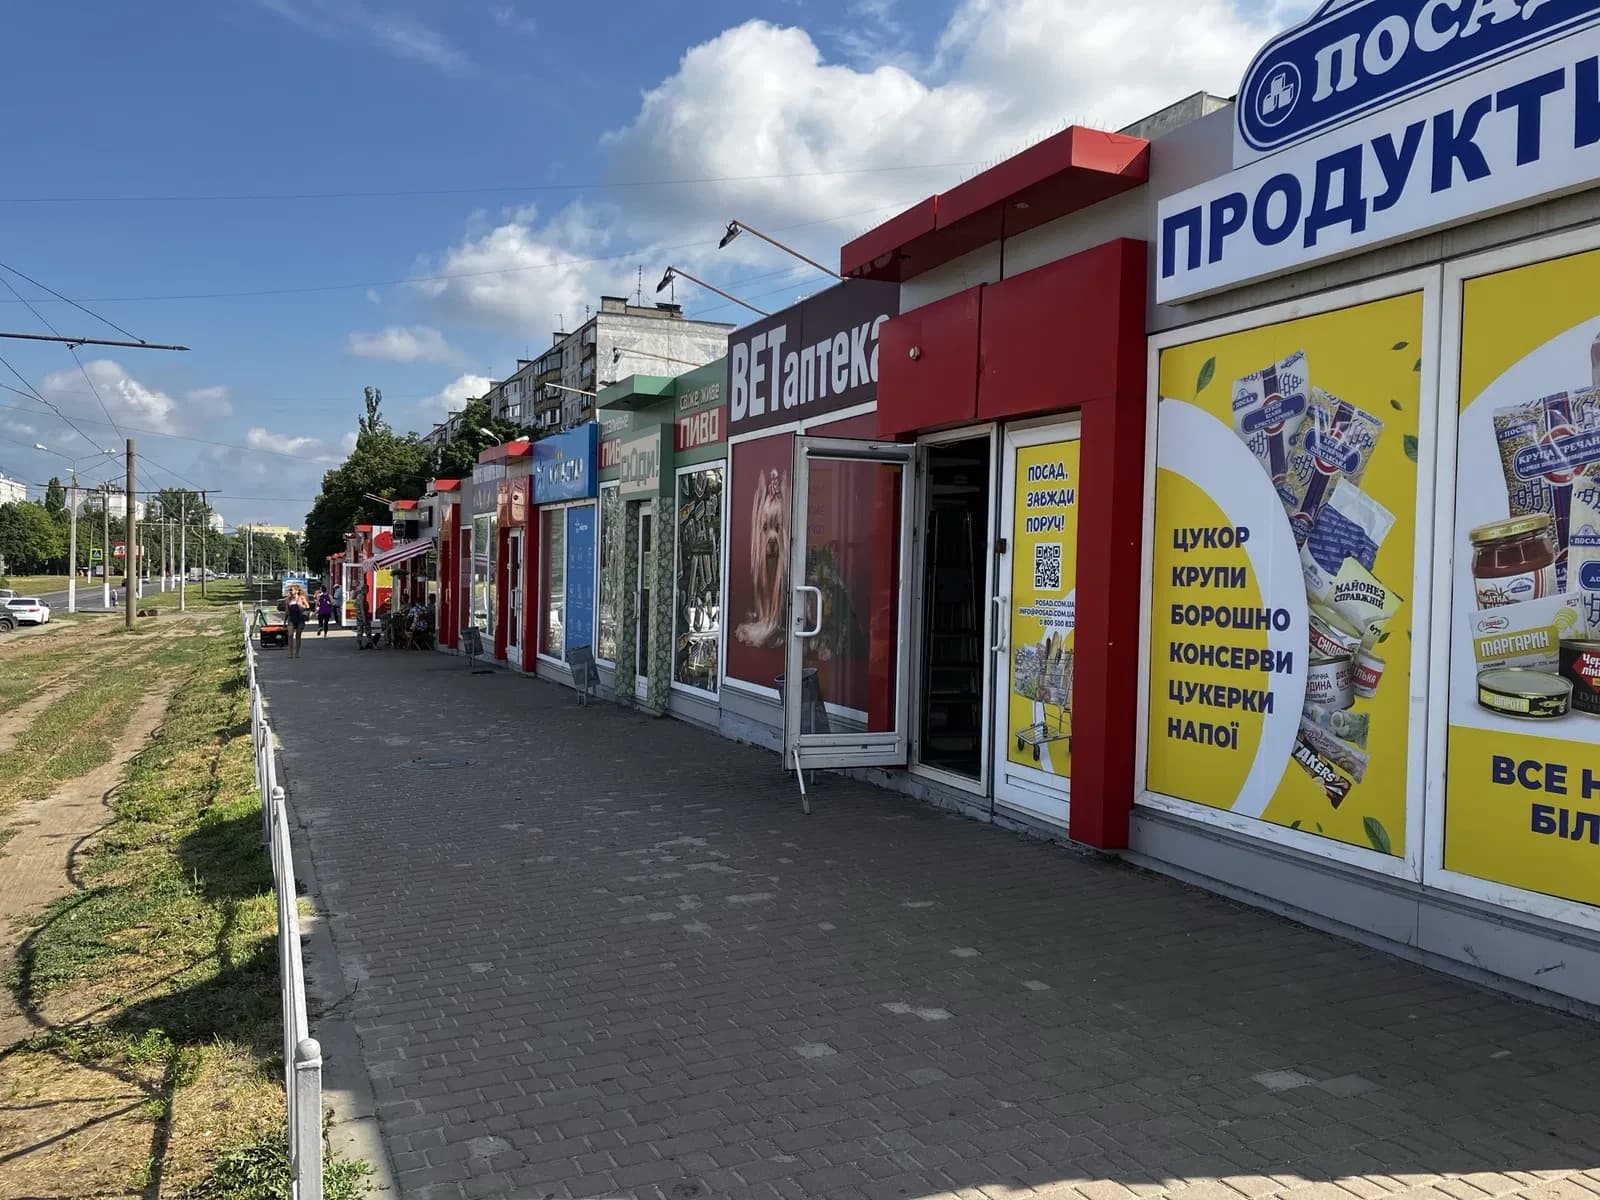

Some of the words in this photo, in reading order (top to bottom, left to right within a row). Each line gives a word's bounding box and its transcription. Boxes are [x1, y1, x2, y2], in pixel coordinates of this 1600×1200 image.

[1312, 0, 1551, 103] ПОСА
[680, 408, 719, 449] ПИВО
[601, 438, 620, 468] ПИВ
[1027, 489, 1074, 507] ЗАВЖДИ
[1026, 515, 1065, 532] ПОРУЧ!
[1173, 526, 1250, 552] ЦУКОР
[1172, 566, 1246, 588] КРУПИ
[1335, 579, 1386, 601] МАЙОНЕЗ
[1334, 594, 1385, 610] СПРАВЖНІЙ
[1171, 604, 1291, 631] БОРОШНО
[1481, 630, 1550, 657] МАРГАРИН
[1169, 642, 1293, 674] КОНСЕРВИ
[1169, 680, 1274, 714] ЦУКЕРКИ
[1168, 717, 1239, 749] НАПОЇ
[1493, 755, 1568, 795] ВСЕ
[1531, 803, 1600, 845] БІЛ
